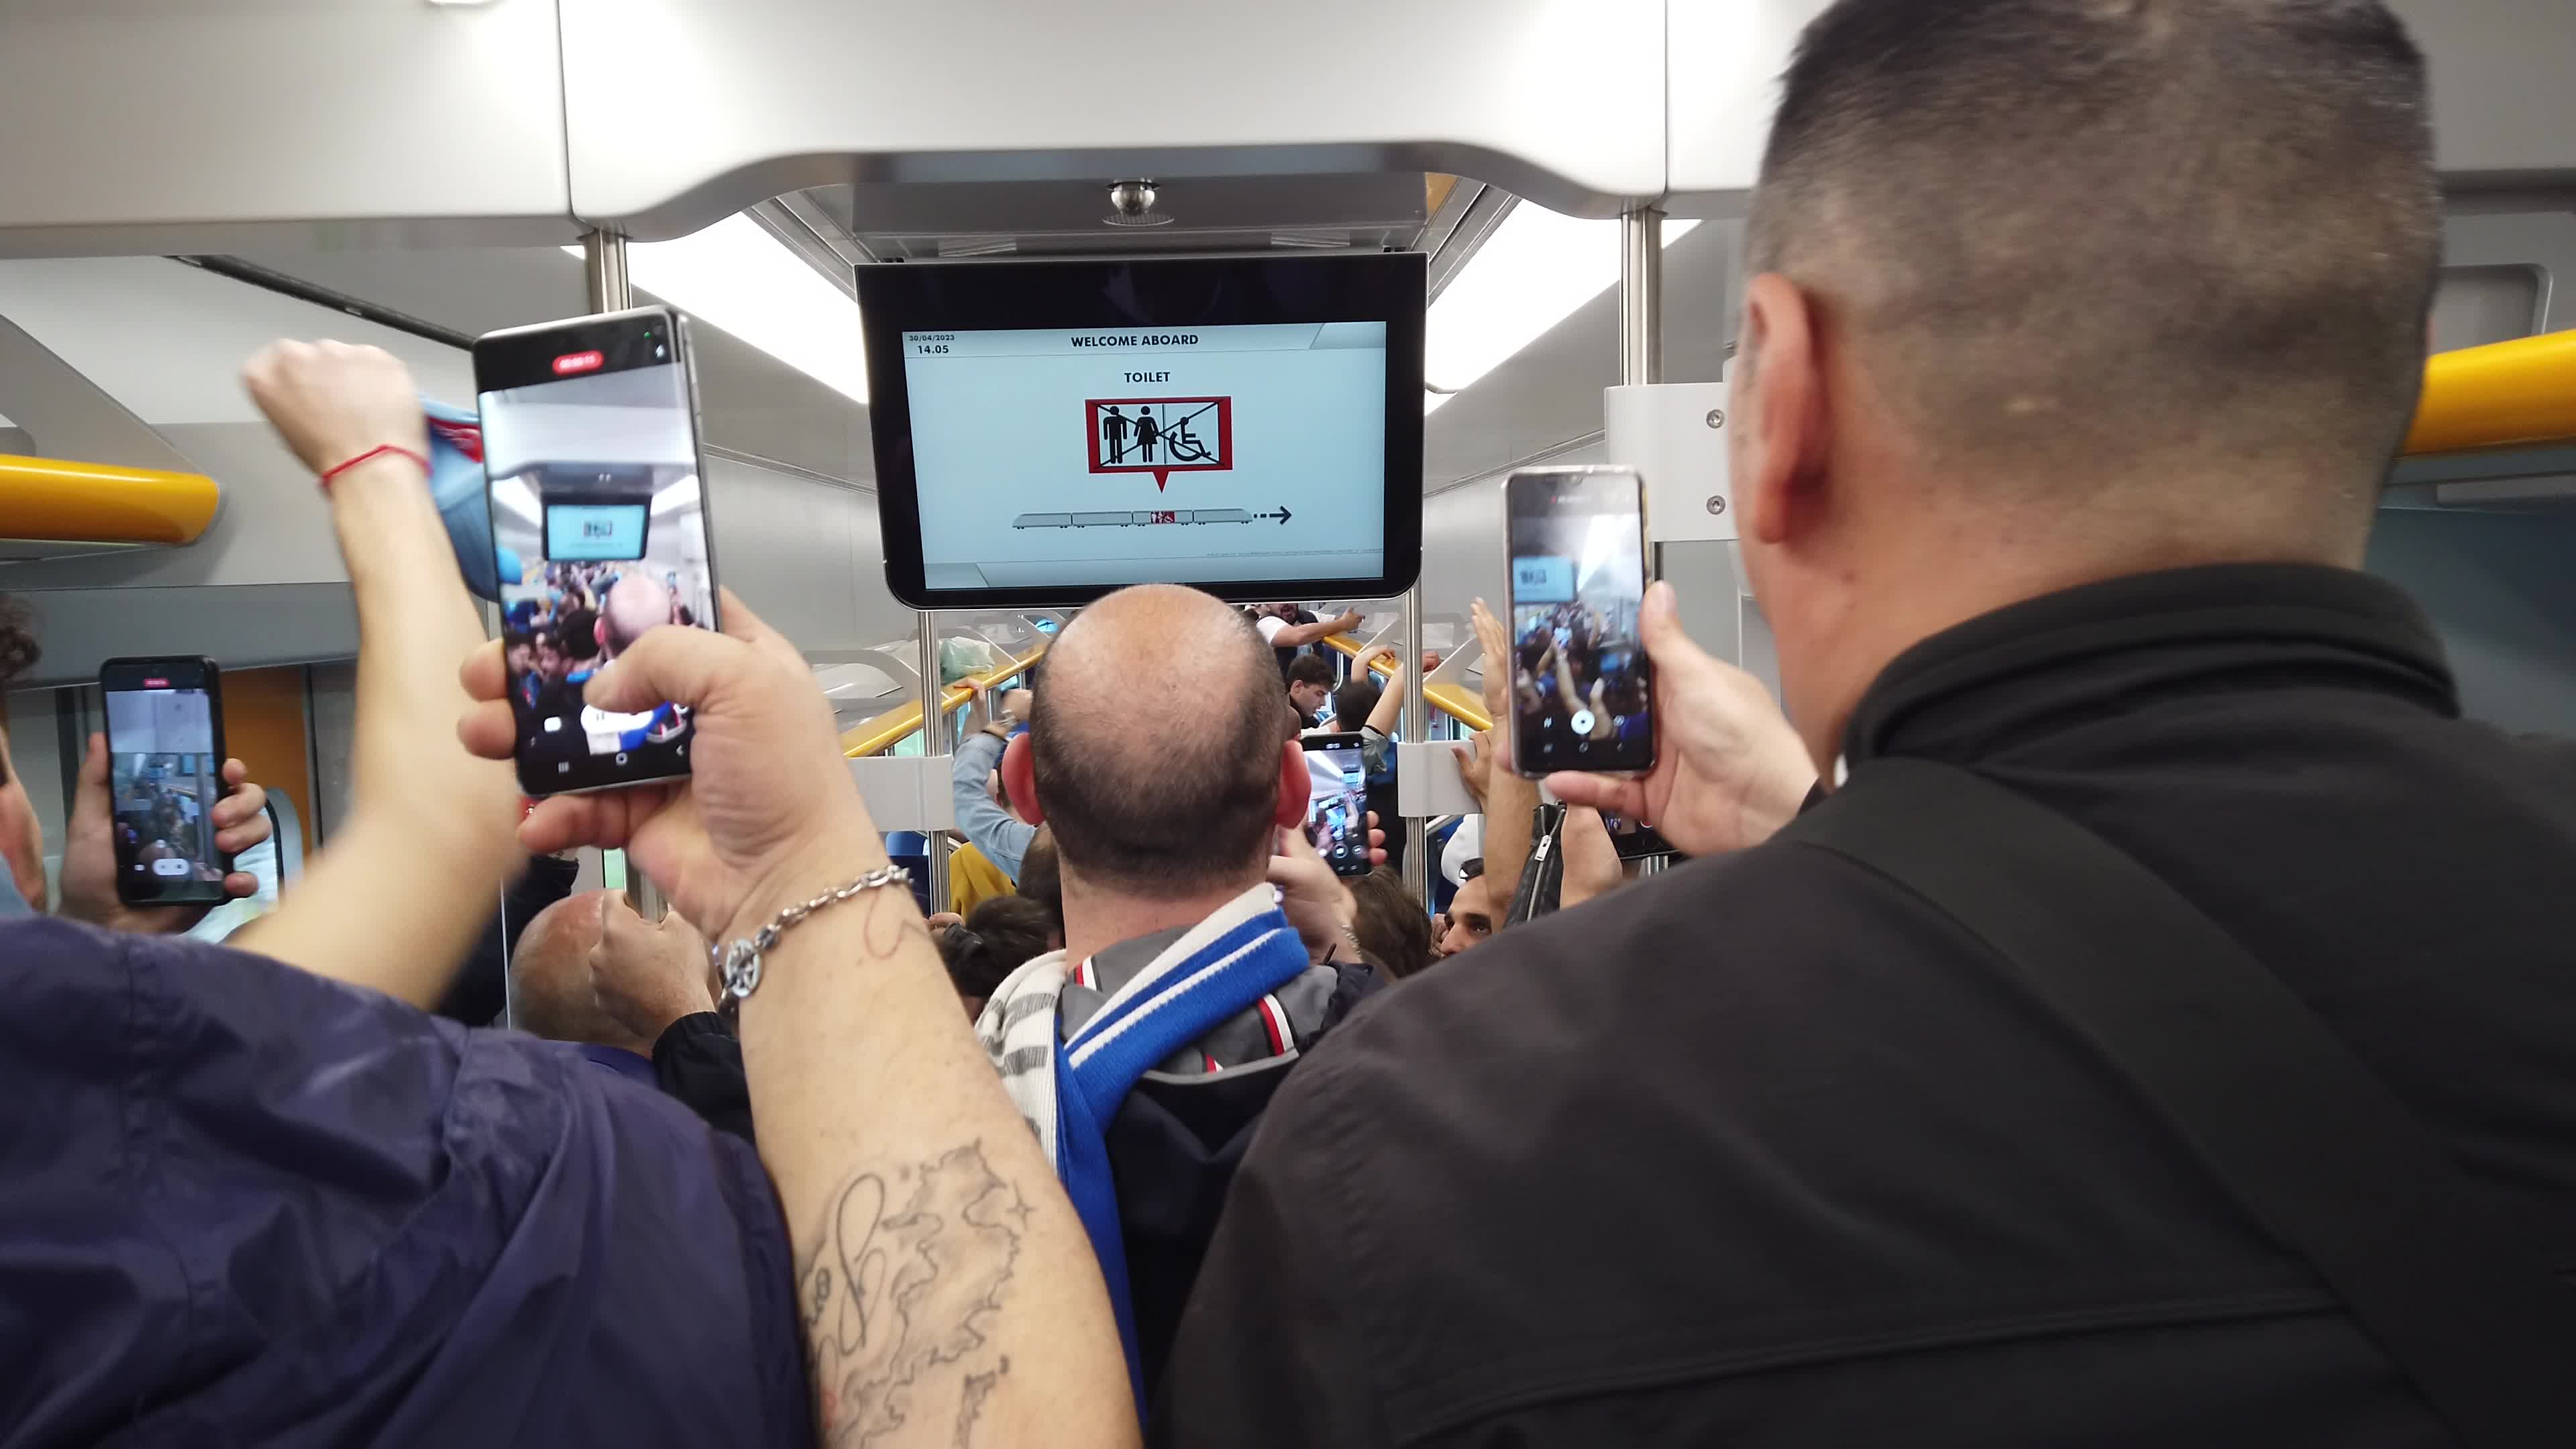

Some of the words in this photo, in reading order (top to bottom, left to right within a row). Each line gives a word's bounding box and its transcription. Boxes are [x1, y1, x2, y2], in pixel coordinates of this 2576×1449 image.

[908, 334, 955, 343] 30/04/2023
[1071, 335, 1137, 347] WELCOME
[1141, 335, 1199, 345] ABOARD
[917, 345, 949, 354] 14.05
[1124, 372, 1171, 383] TOILET
